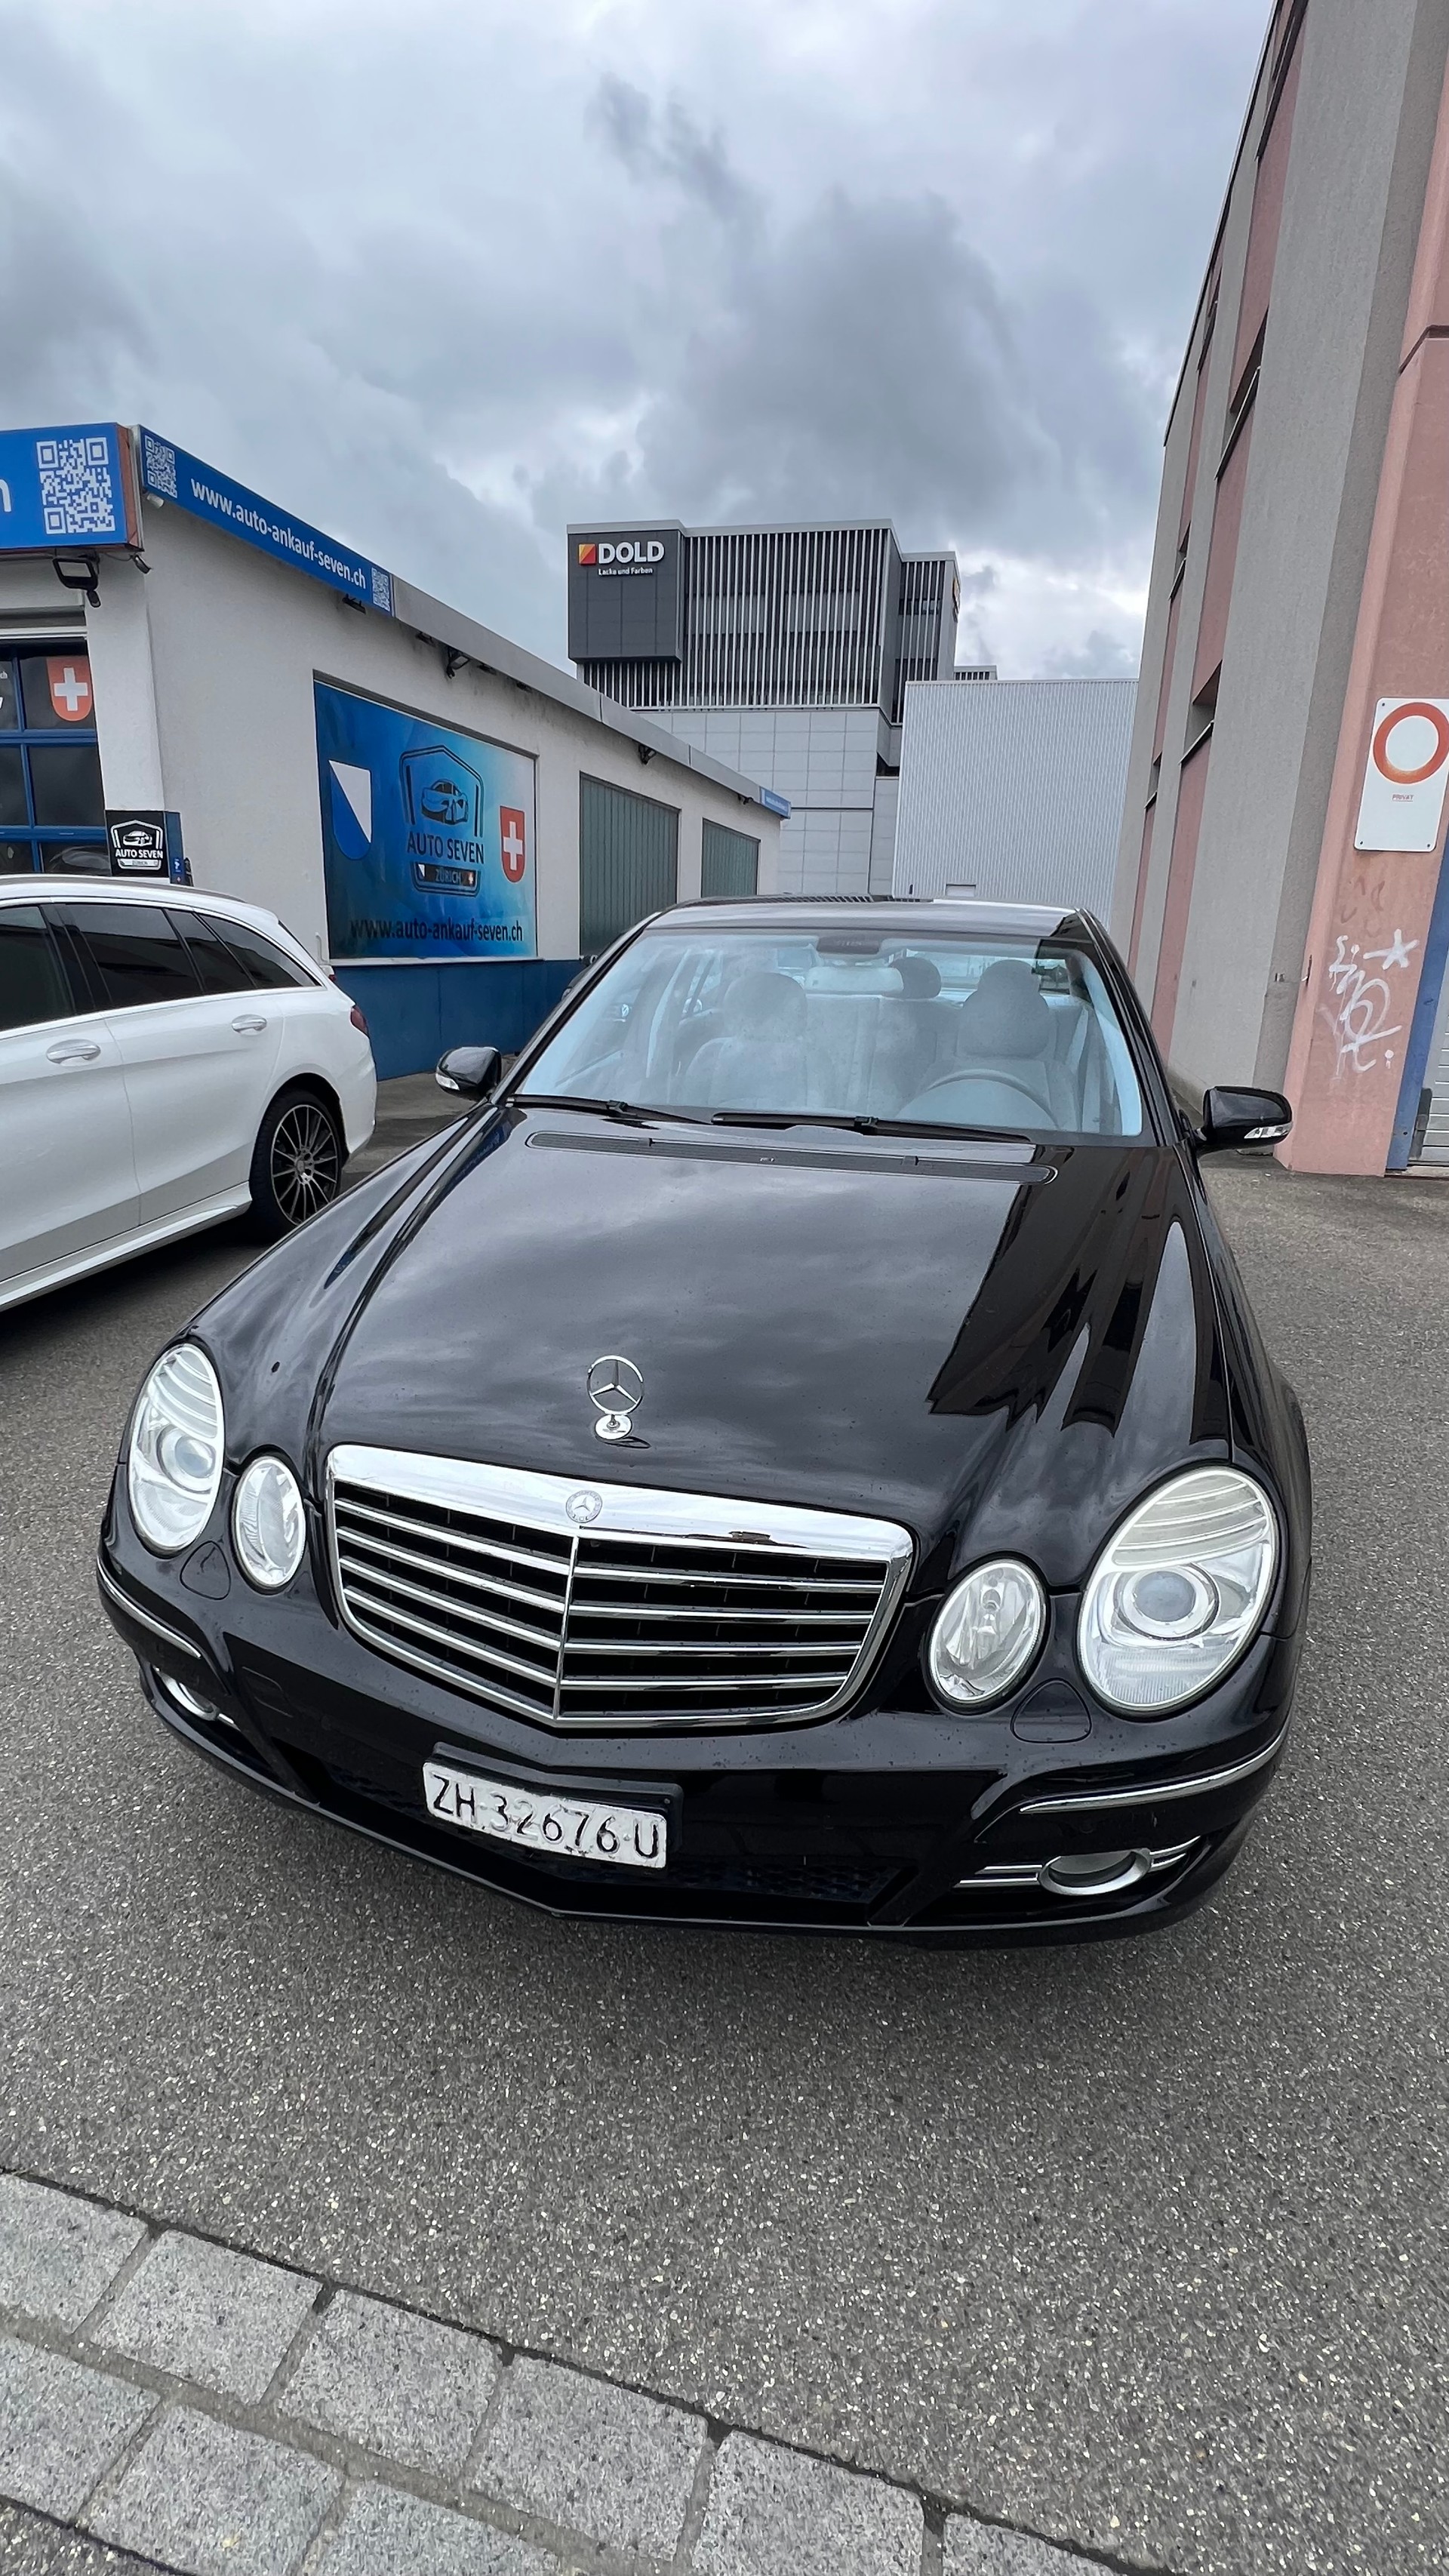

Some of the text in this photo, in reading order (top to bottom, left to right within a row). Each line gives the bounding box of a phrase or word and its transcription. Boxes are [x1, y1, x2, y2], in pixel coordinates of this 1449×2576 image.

[191, 478, 367, 589] www.auto-ankauf-seven.ch
[598, 541, 664, 565] DOLD
[631, 566, 653, 574] Farben
[115, 849, 163, 859] AUTO SEVEN
[407, 831, 485, 864] AUTO SEVEN
[350, 917, 524, 942] www.auto-ankauf-seven.ch
[432, 1773, 660, 1860] ZH 32676 U
